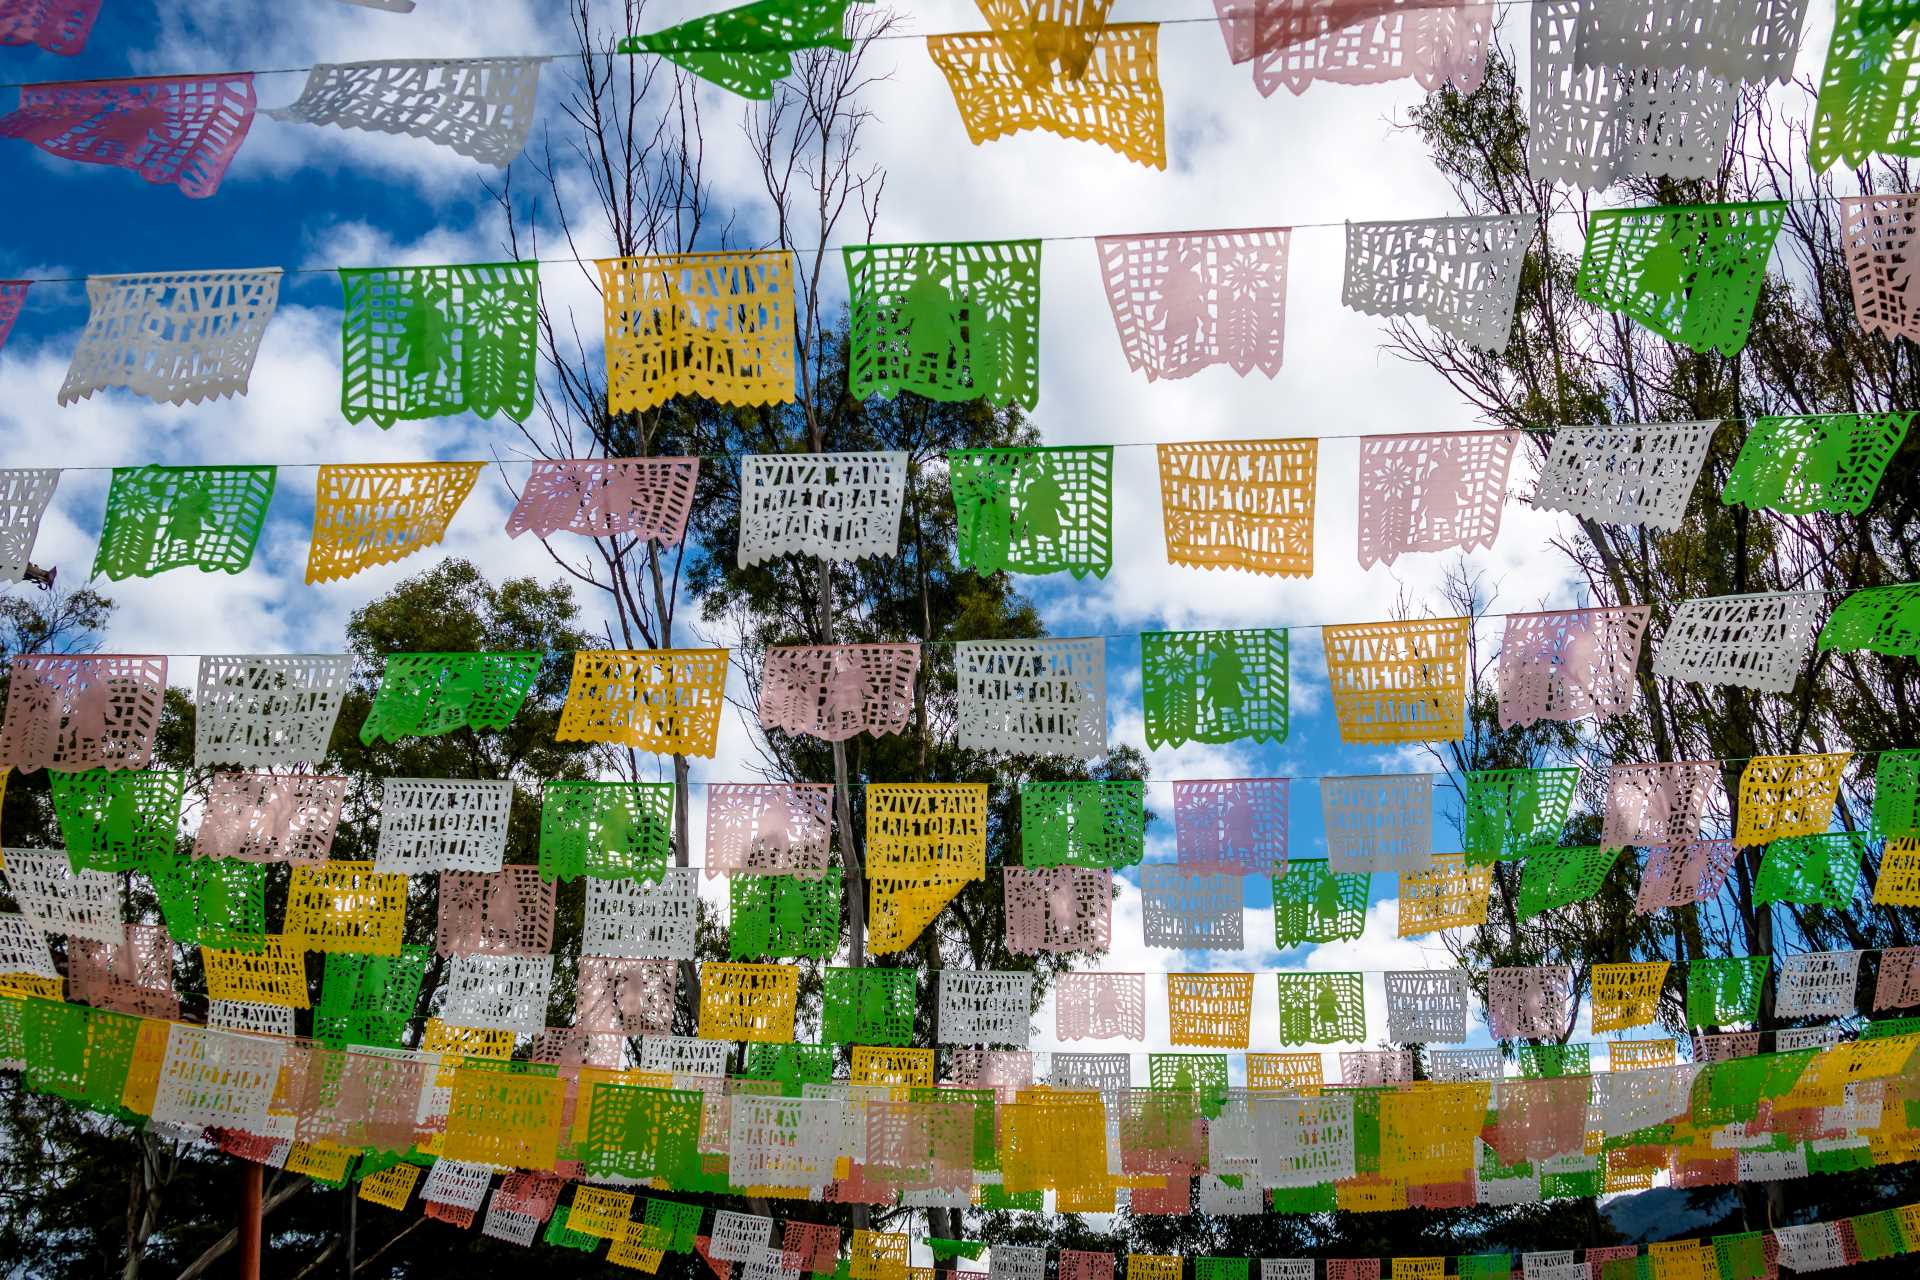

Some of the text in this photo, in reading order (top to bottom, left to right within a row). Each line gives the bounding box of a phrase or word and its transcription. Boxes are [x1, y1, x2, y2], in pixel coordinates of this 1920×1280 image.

[1000, 92, 1122, 138] MARTIR
[1574, 434, 1638, 452] VIVA
[760, 464, 884, 487] VIVA SAN
[1176, 454, 1297, 482] VIVA SAN
[336, 475, 402, 501] VIVA
[1176, 480, 1300, 515] CRISTOBAL
[757, 486, 883, 514] CRISTOBAL
[768, 513, 866, 542] MARTIR
[1193, 519, 1282, 553] MARTIR
[1693, 604, 1746, 623] VIVA
[1682, 621, 1793, 643] CRISTOBAL
[1339, 633, 1450, 662] VIVA SAN
[974, 654, 1086, 678] VIVA SAN
[1685, 650, 1770, 673] MARTIR
[214, 665, 274, 690] VIVA
[591, 662, 707, 684] VIVA SAN
[1342, 662, 1448, 690] CRISTOBAL
[583, 681, 706, 709] CRISTOBAL
[973, 677, 1087, 704] CRISTOBAL
[987, 709, 1074, 735] MARTIR
[398, 790, 496, 810] VIVA SAN
[880, 795, 973, 814] VIVA SAN
[391, 812, 491, 833] CRISTOBAL
[877, 816, 972, 836] CRISTOBAL
[400, 839, 477, 858] MARTIR
[888, 843, 960, 863] MARTIR
[214, 954, 294, 977] CRISTOBAL
[227, 974, 287, 996] MARTIR
[950, 979, 987, 995] VIVA
[1177, 982, 1242, 998] VIVA SAN
[1393, 979, 1457, 995] VIVA SAN
[1176, 998, 1242, 1015] CRISTOBAL
[1394, 995, 1457, 1011] CRISTOBAL
[1186, 1018, 1236, 1038] MARTIR
